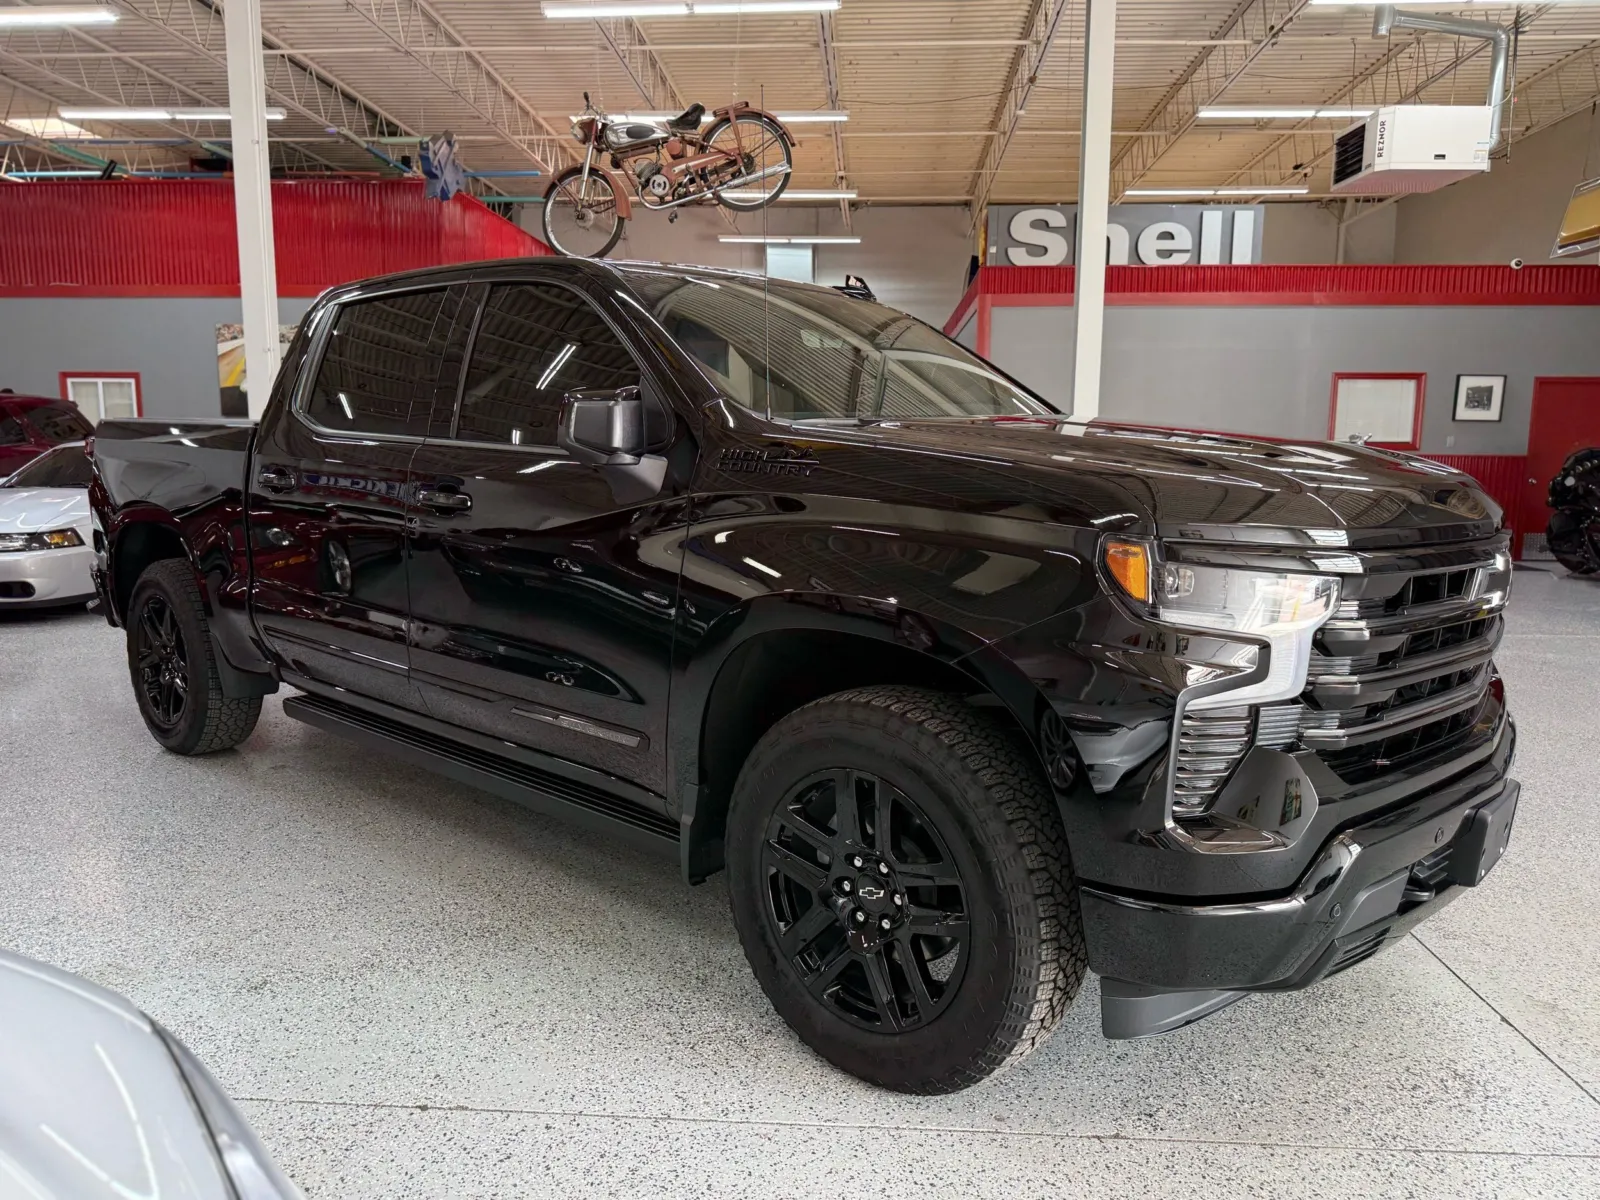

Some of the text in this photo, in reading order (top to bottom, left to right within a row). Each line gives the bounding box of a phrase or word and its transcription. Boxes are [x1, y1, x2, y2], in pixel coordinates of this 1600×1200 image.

[1377, 120, 1387, 158] REZNOR
[720, 448, 768, 461] HIGH
[716, 461, 817, 477] COUNTRY
